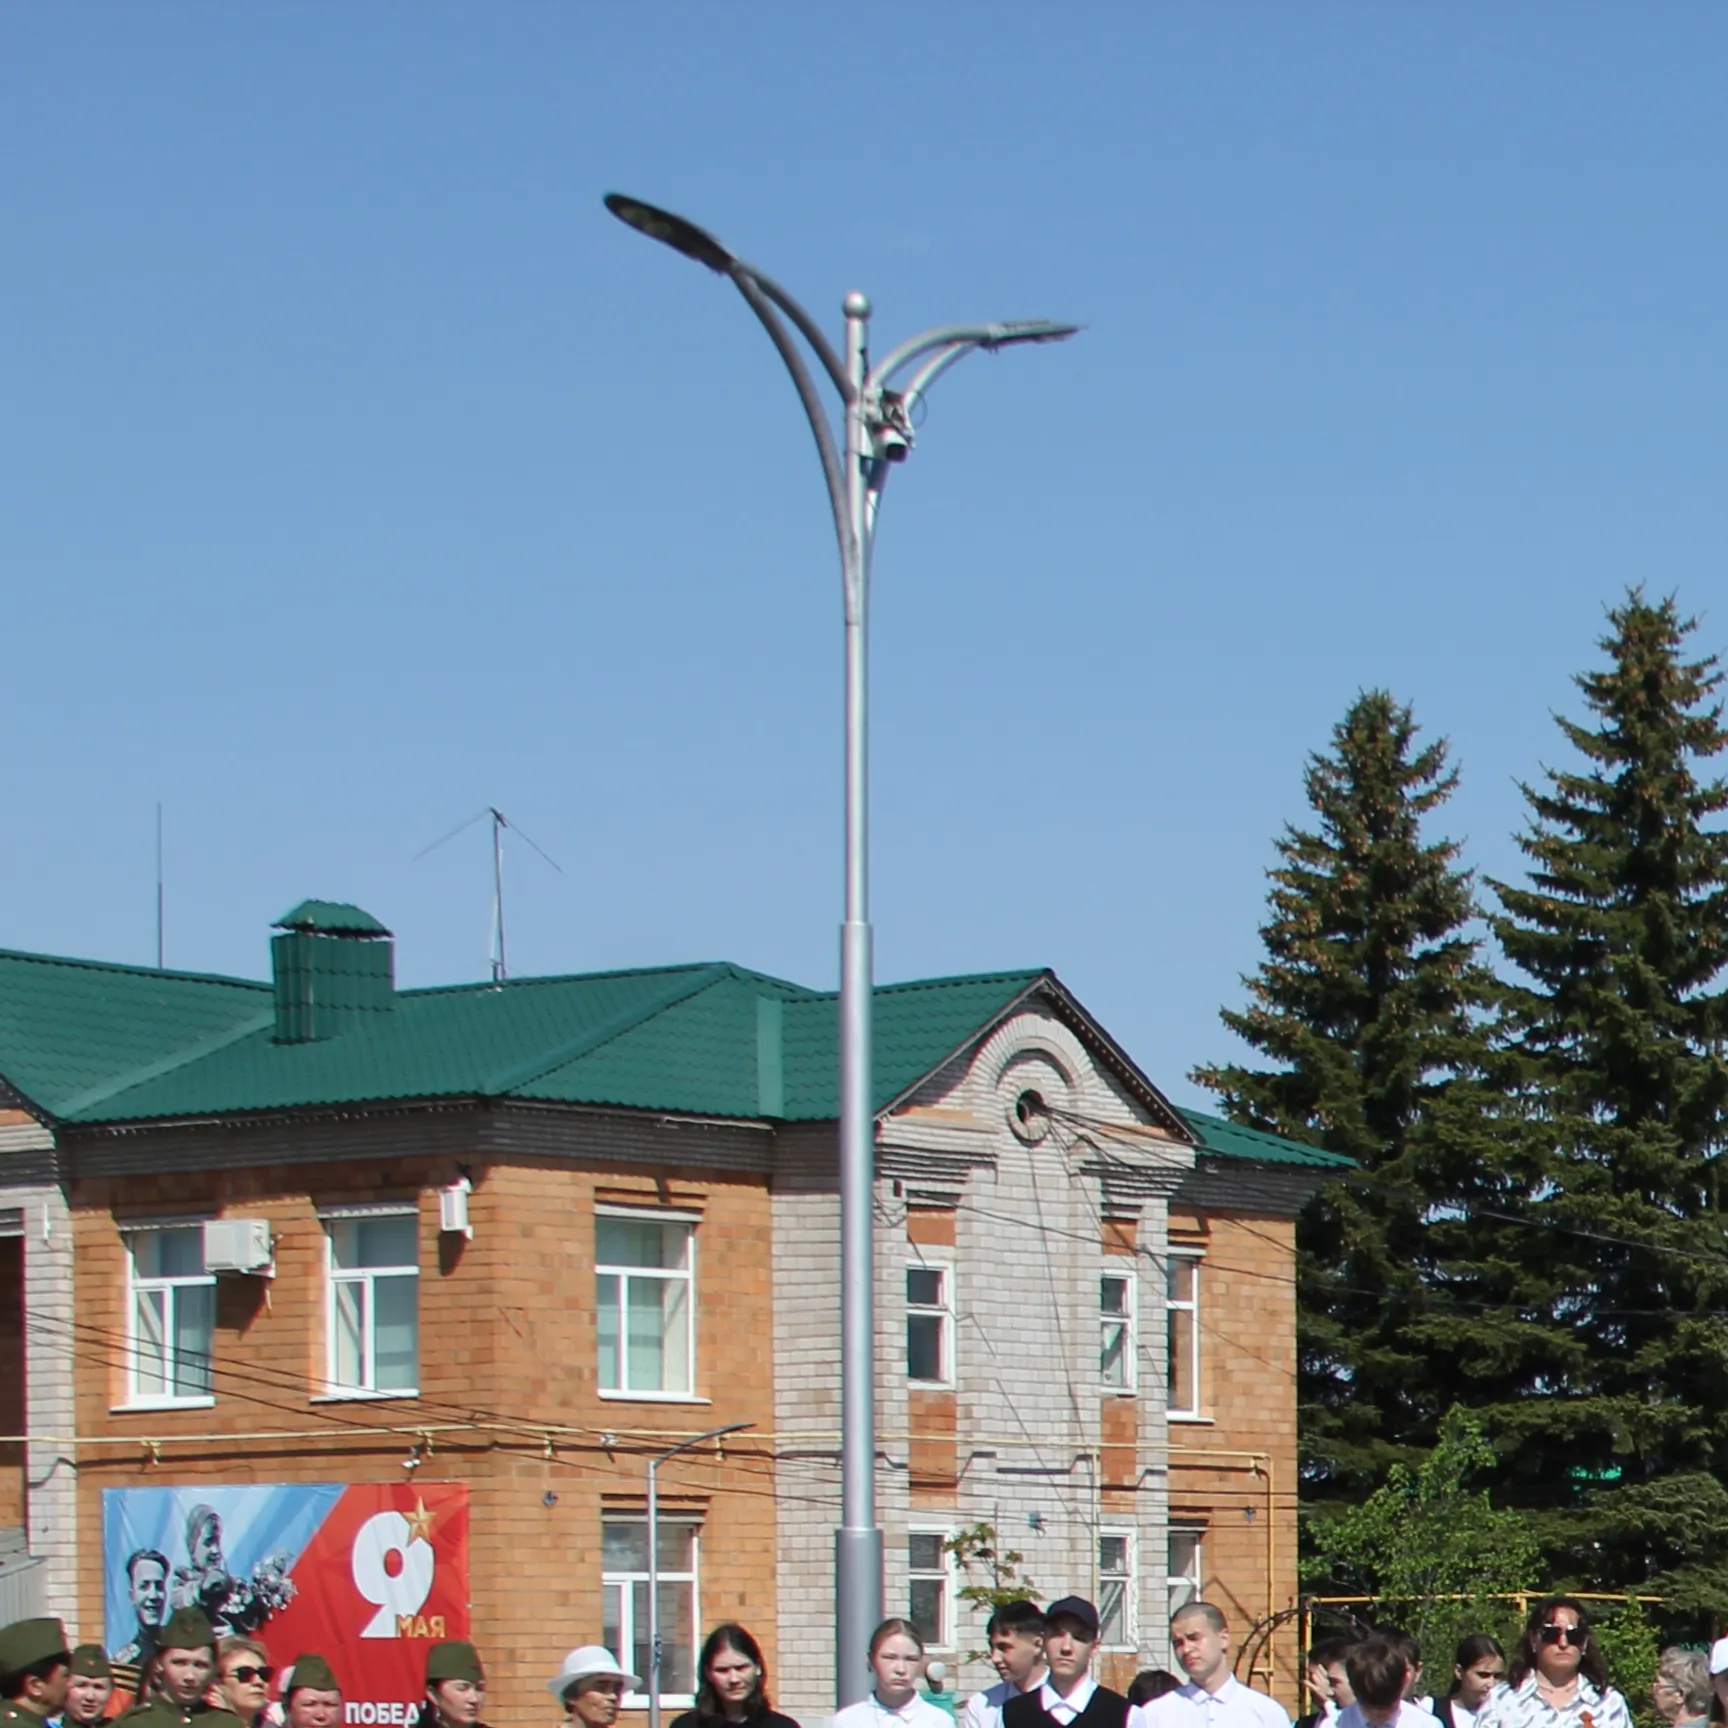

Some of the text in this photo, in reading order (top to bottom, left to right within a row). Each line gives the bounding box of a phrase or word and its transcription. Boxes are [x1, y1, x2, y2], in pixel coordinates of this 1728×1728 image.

[353, 1511, 446, 1638] 9 МАЯ
[345, 1702, 427, 1728] ПОБЕД
